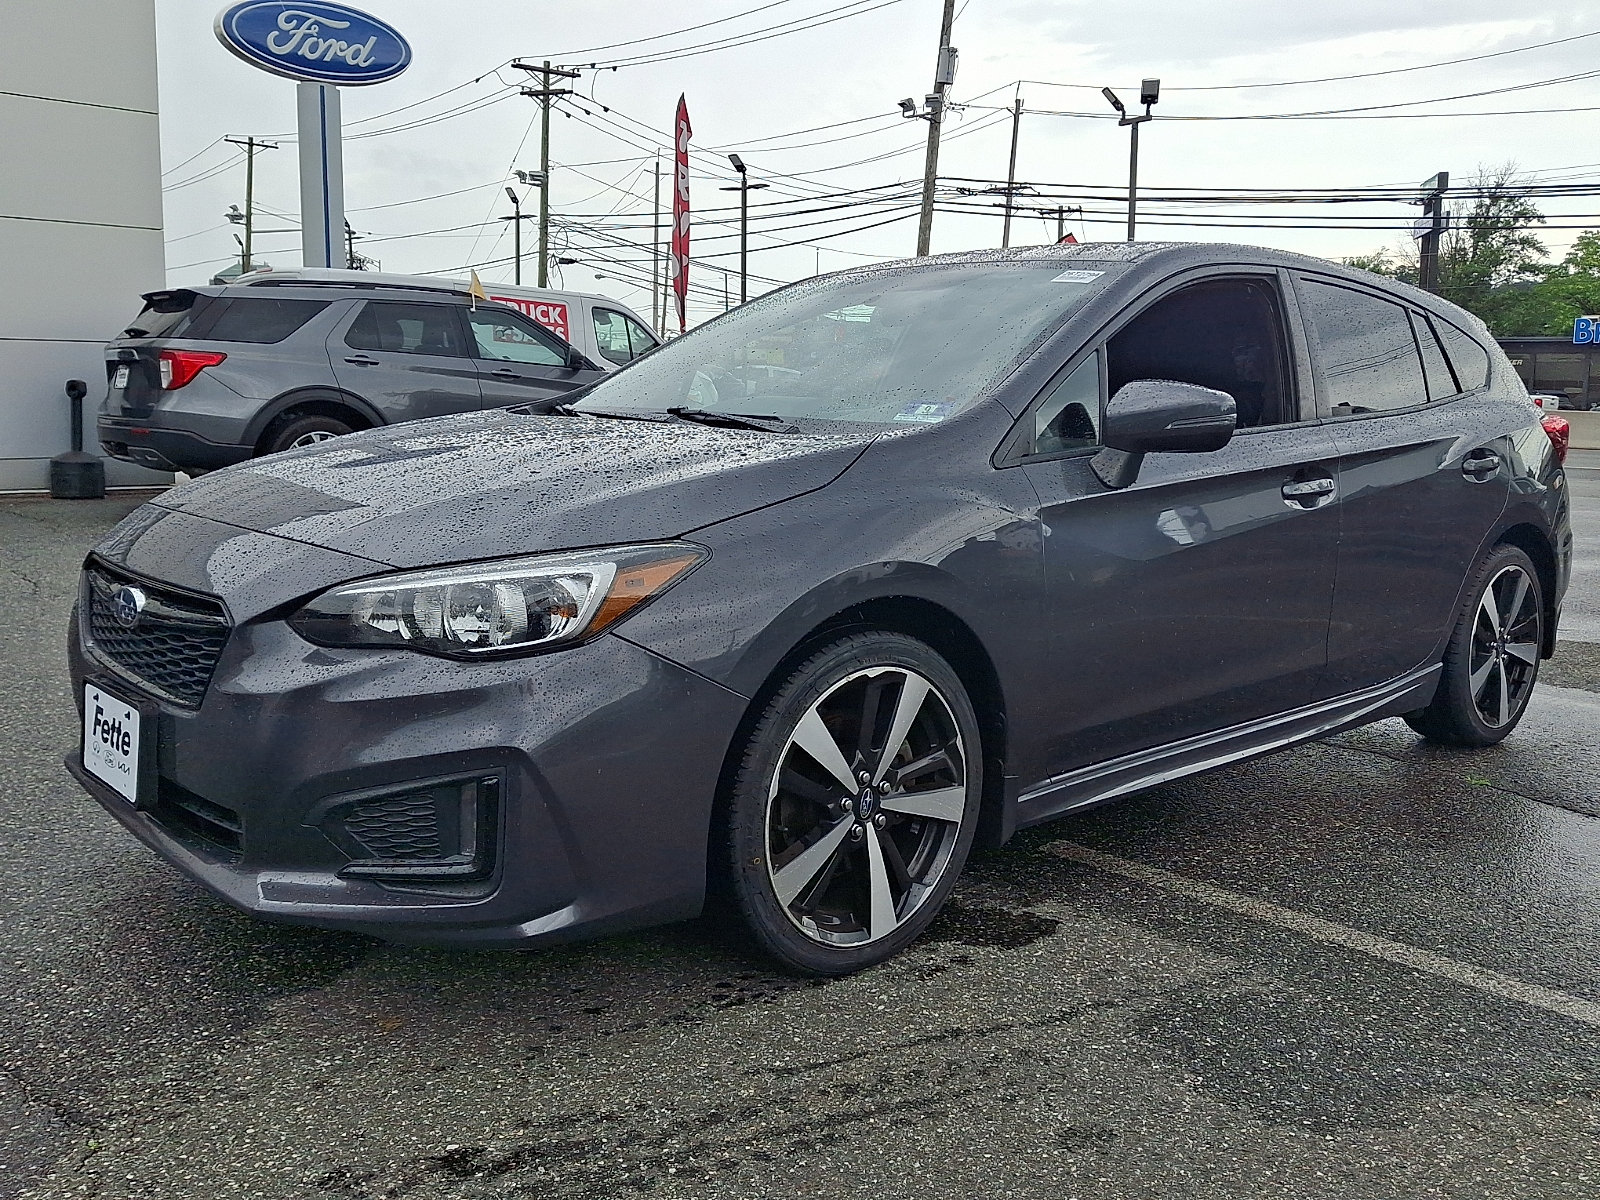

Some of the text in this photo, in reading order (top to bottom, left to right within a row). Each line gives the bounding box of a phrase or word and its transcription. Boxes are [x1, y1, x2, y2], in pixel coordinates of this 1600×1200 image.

[266, 10, 378, 68] Ford
[493, 299, 564, 325] UCK
[92, 704, 131, 756] Fette
